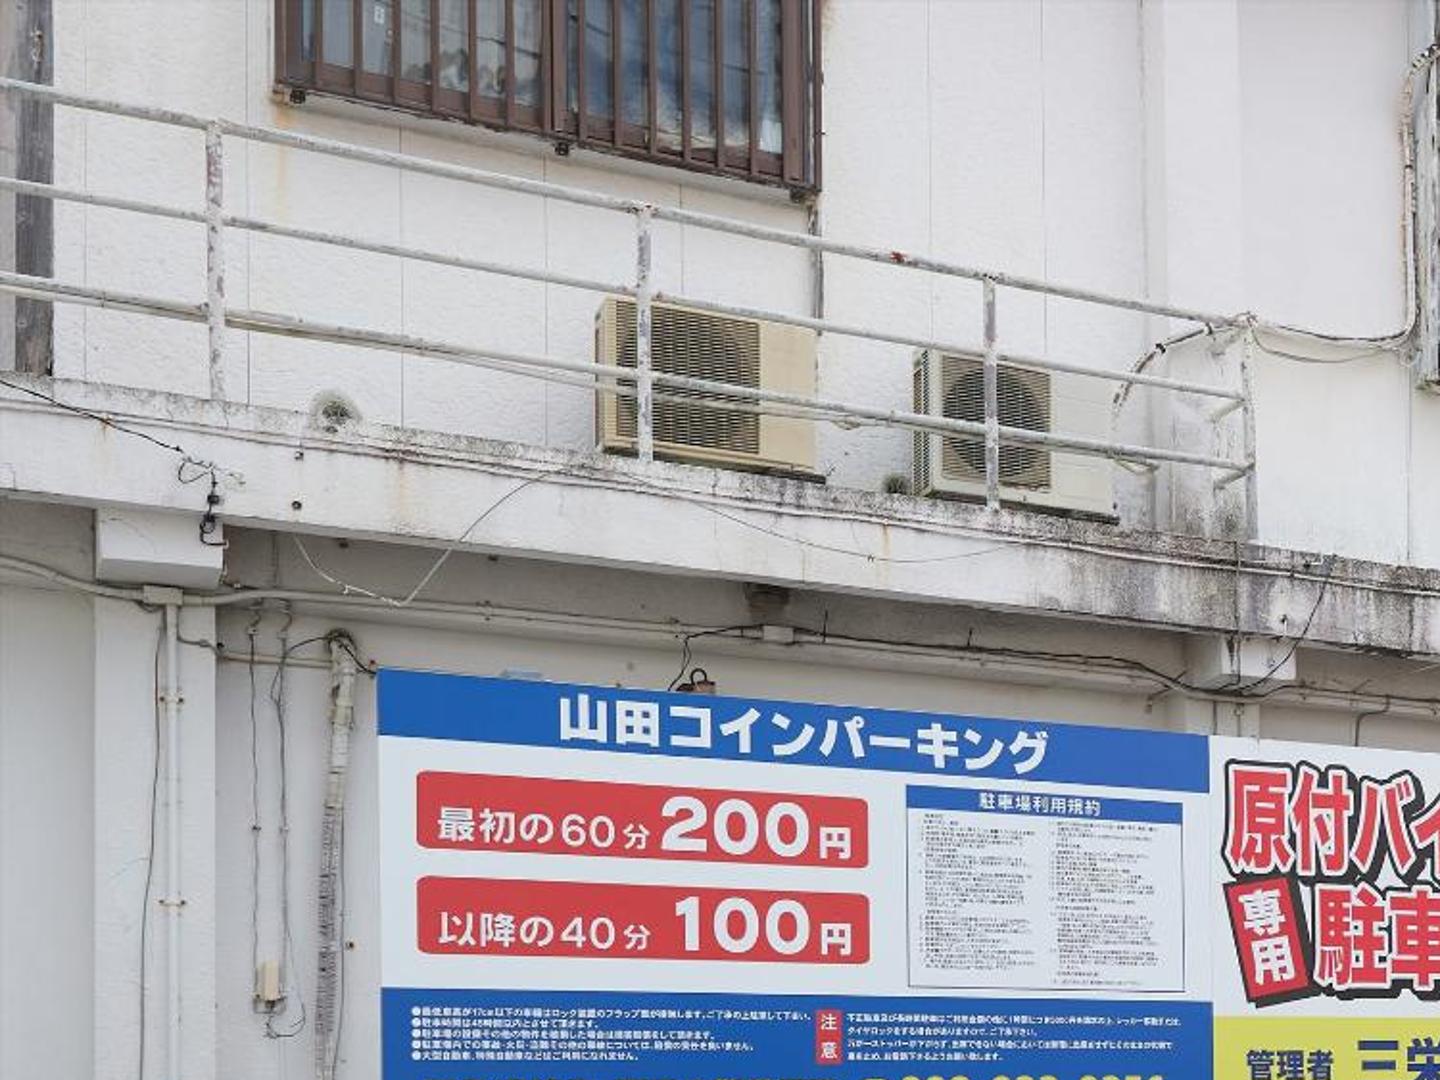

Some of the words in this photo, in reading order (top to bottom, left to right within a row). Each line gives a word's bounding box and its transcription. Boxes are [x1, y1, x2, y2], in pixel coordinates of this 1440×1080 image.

[559, 694, 1050, 774] 山田コインパーキング
[437, 806, 651, 850] 最初の60分
[661, 795, 853, 860] 200円
[979, 792, 1101, 817] 駐車場利用規約
[438, 911, 651, 950] 以降の40分
[674, 895, 853, 956] 100円
[1238, 886, 1293, 986] 専用
[820, 1013, 838, 1060] 注意
